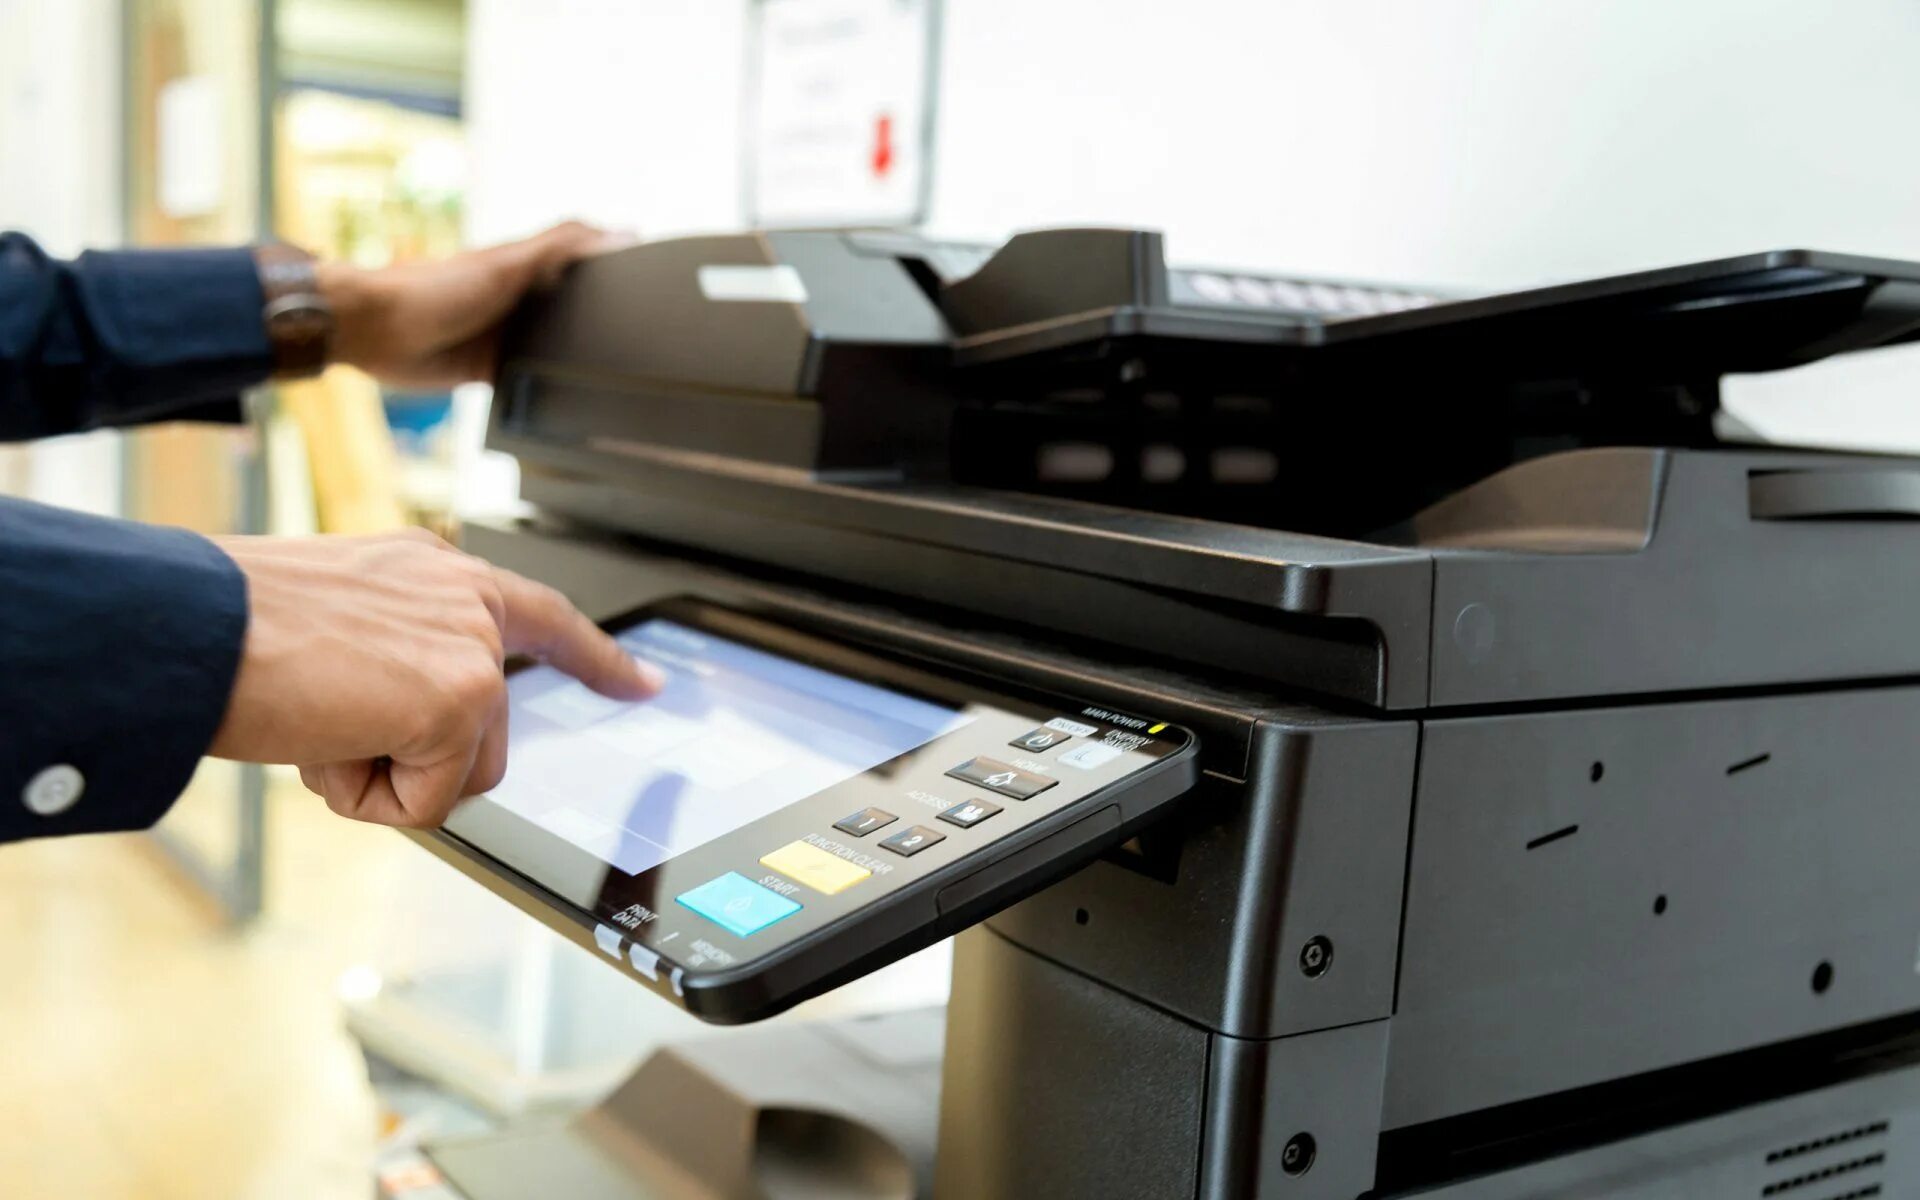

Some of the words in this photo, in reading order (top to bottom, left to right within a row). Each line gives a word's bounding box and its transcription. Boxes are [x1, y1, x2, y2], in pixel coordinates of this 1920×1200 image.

[859, 817, 876, 829] 1
[803, 833, 859, 859] FUNCTION
[901, 835, 923, 848] 2
[759, 875, 800, 896] START
[612, 911, 642, 931] DATA
[625, 903, 660, 923] PRINT
